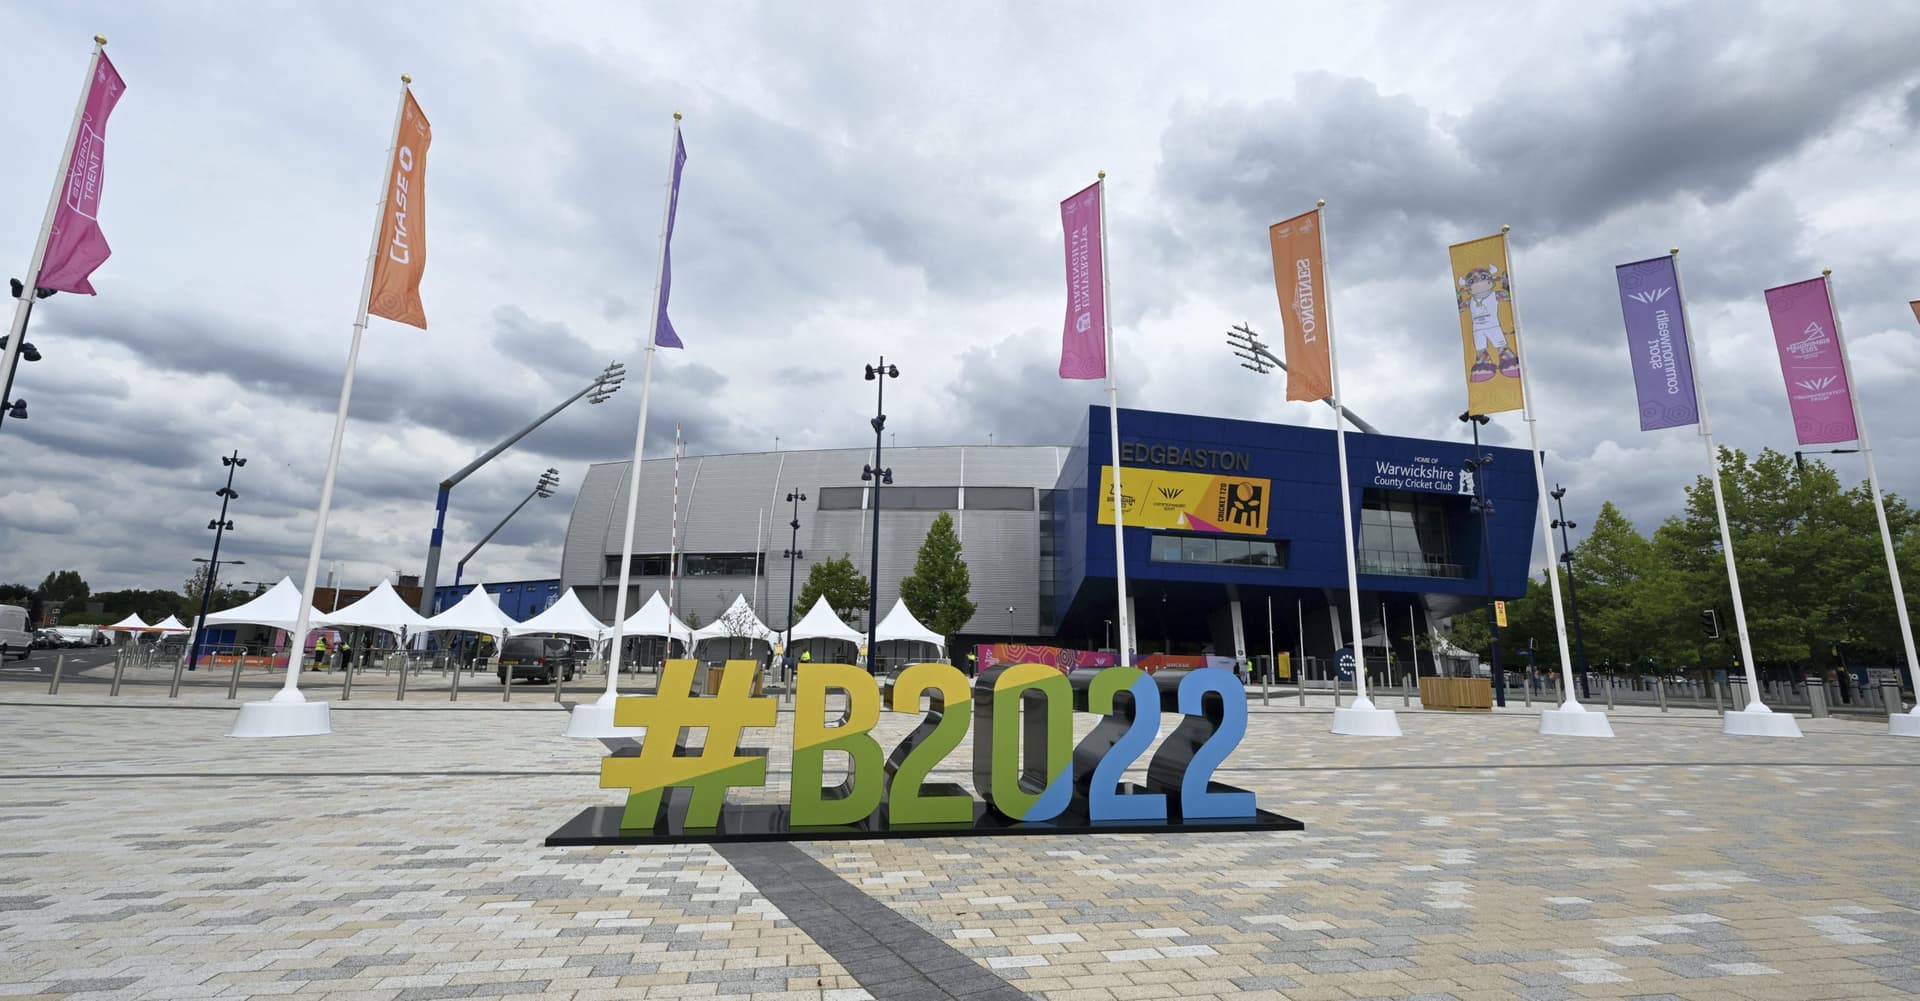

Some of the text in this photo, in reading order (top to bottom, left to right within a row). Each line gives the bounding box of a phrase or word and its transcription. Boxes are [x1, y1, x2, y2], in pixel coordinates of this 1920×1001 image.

[72, 136, 91, 200] SEVERN
[83, 151, 102, 201] TRENT
[1120, 442, 1249, 471] EDGBASTON
[1414, 456, 1430, 464] HOME
[1374, 475, 1453, 491] County Cricket Club
[1376, 461, 1454, 480] Warwickshire
[1218, 497, 1226, 522] CRICKET
[600, 659, 1257, 830] #B2022
